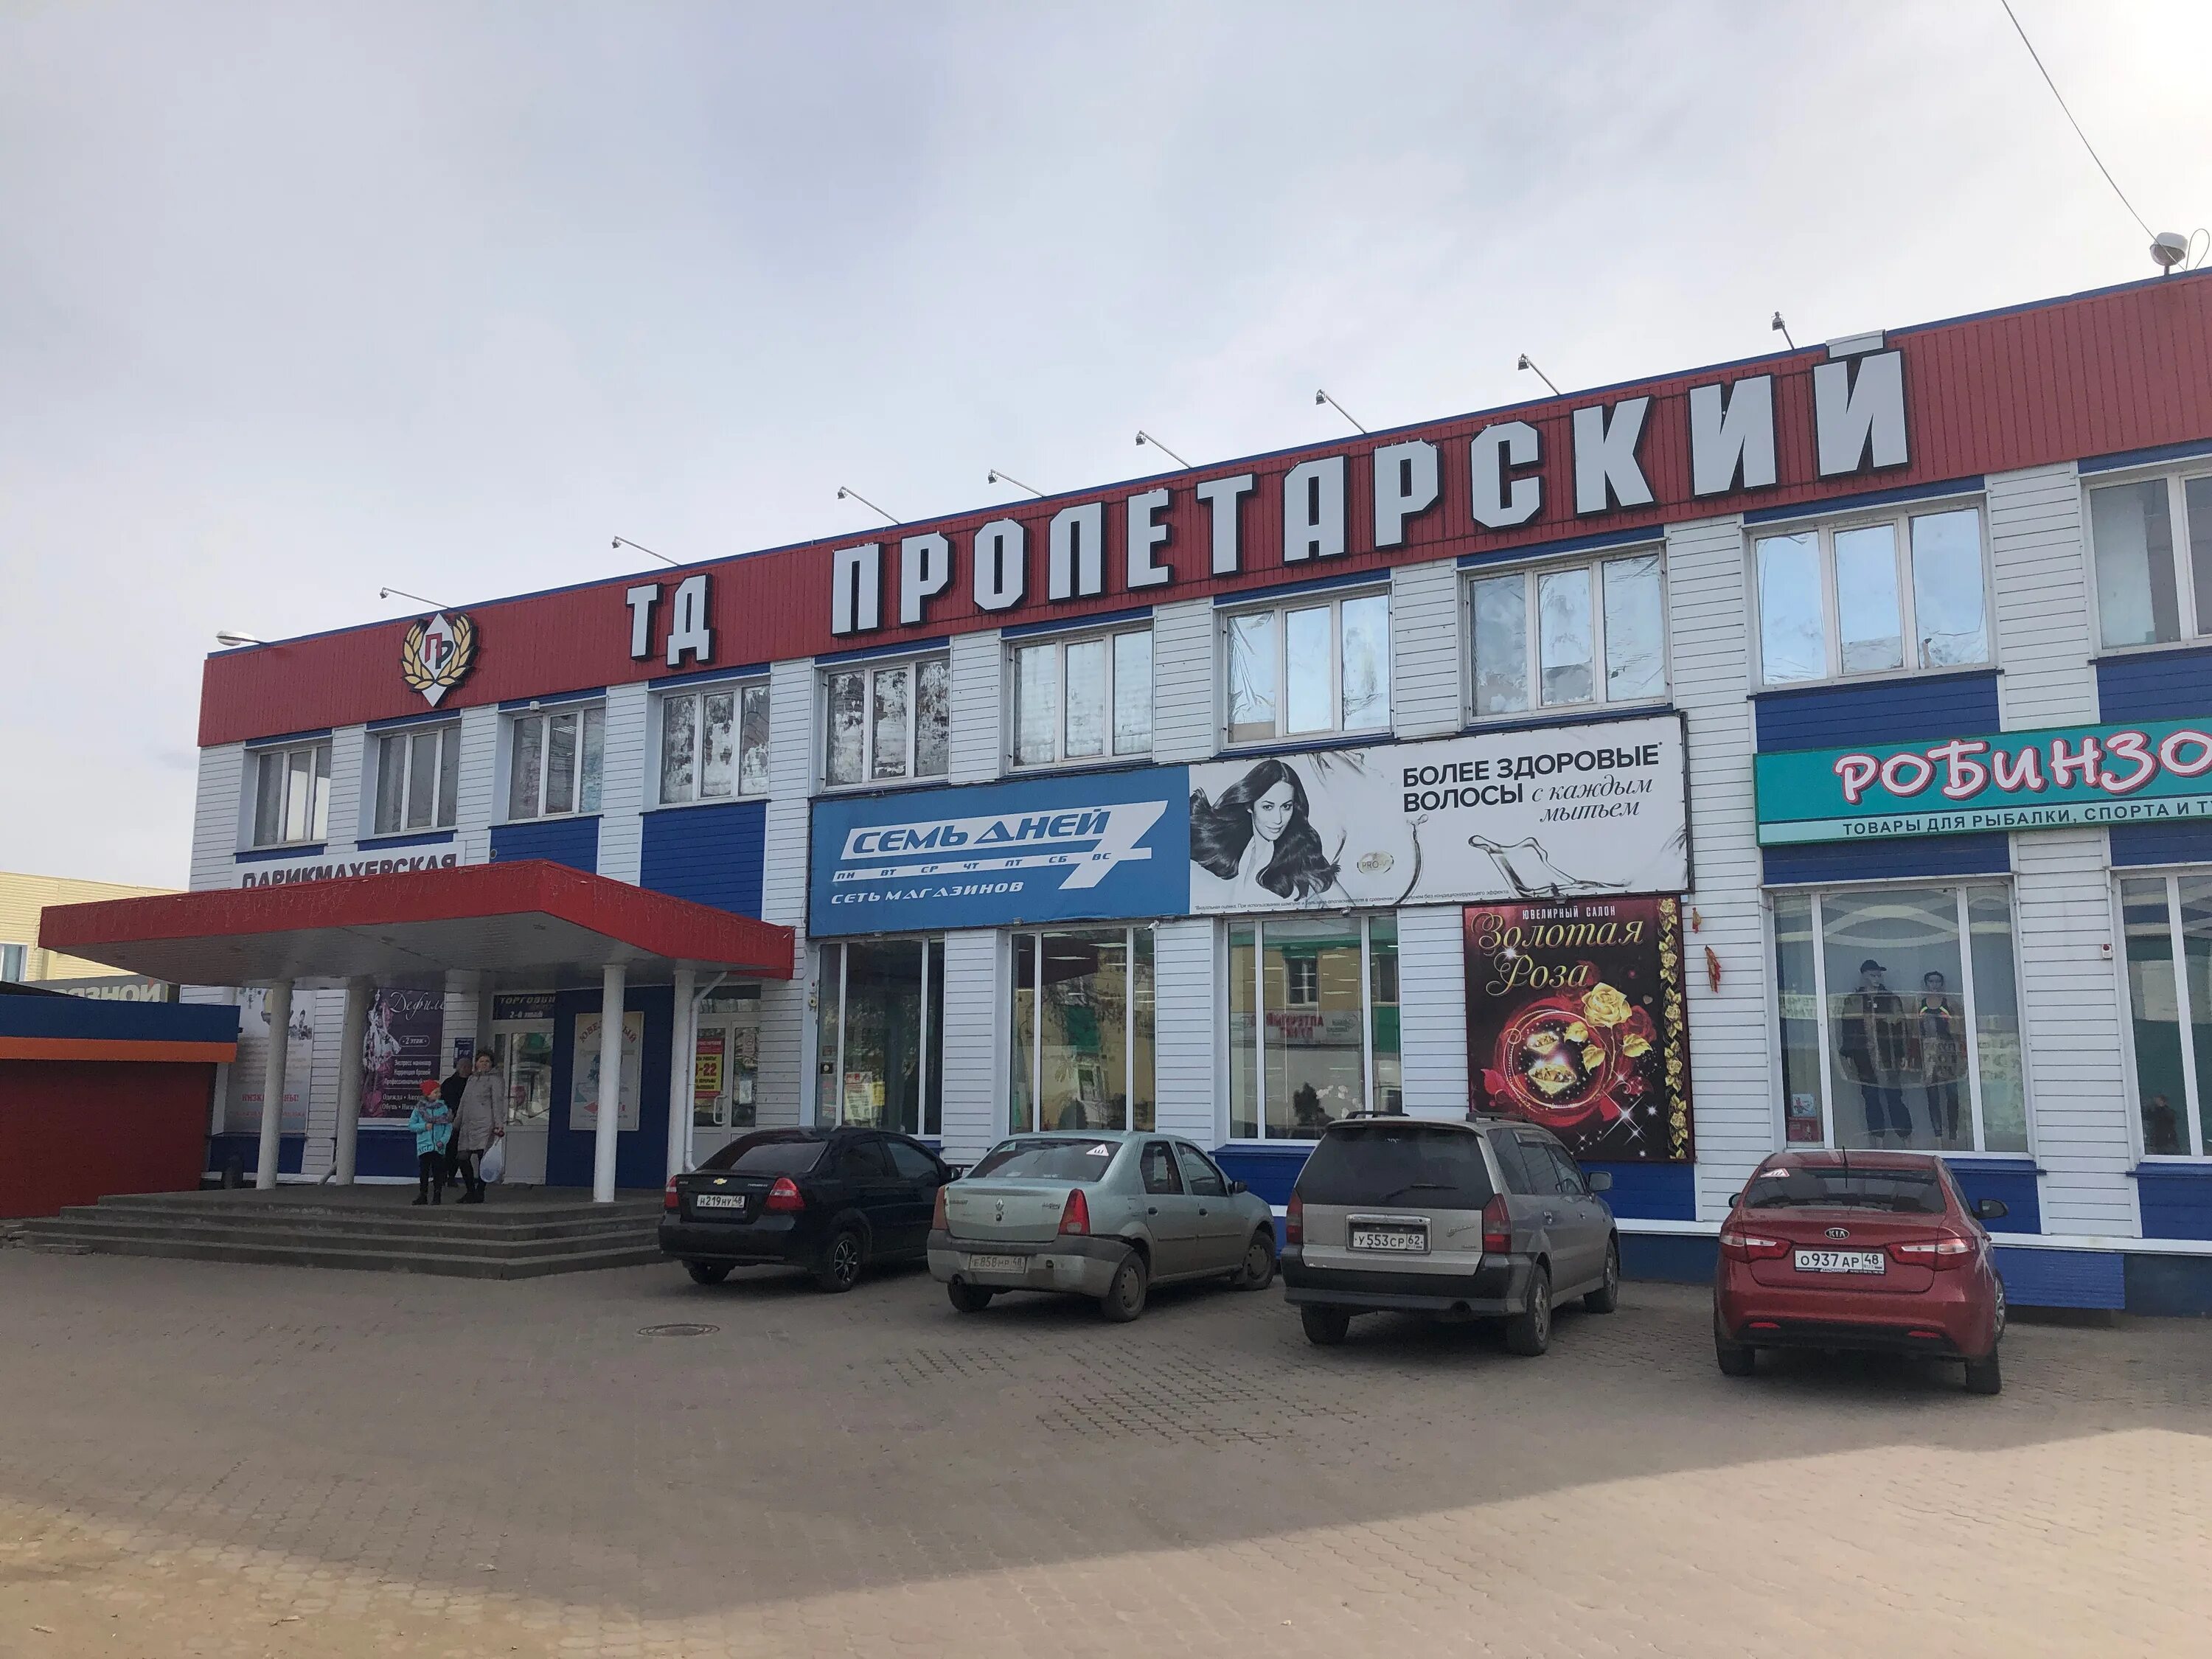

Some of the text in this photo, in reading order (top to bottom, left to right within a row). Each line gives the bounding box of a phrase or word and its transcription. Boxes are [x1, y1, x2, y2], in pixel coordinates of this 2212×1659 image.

[626, 329, 1909, 667] ТД ПРОЛЕТАРСКИЙ
[1403, 759, 1489, 787] БОЛЕЕ
[1404, 773, 1653, 813] ВОЛОСЫ с каждым
[1540, 801, 1640, 823] мытьем
[1843, 801, 2212, 836] ТОВАРЫ ДЛЯ РЫБАЛКИ, СПОРТА И Т
[853, 808, 1111, 854] СЕМЬ ДНЕЙ
[242, 853, 457, 889] ПАРИКМАХЕРСКАЯ
[837, 872, 855, 880] ПН
[1092, 852, 1111, 860] ВС
[831, 881, 1024, 904] СЕТЬ МАГАЗИНОВ
[1522, 905, 1616, 920] ЮВЕЛИРНЫЙ САЛОН
[1471, 911, 1644, 956] Золотая
[1486, 951, 1590, 996] Роза
[1408, 1234, 1420, 1245] 62
[1828, 1230, 1846, 1238] KIA
[1864, 1254, 1879, 1265] 48
